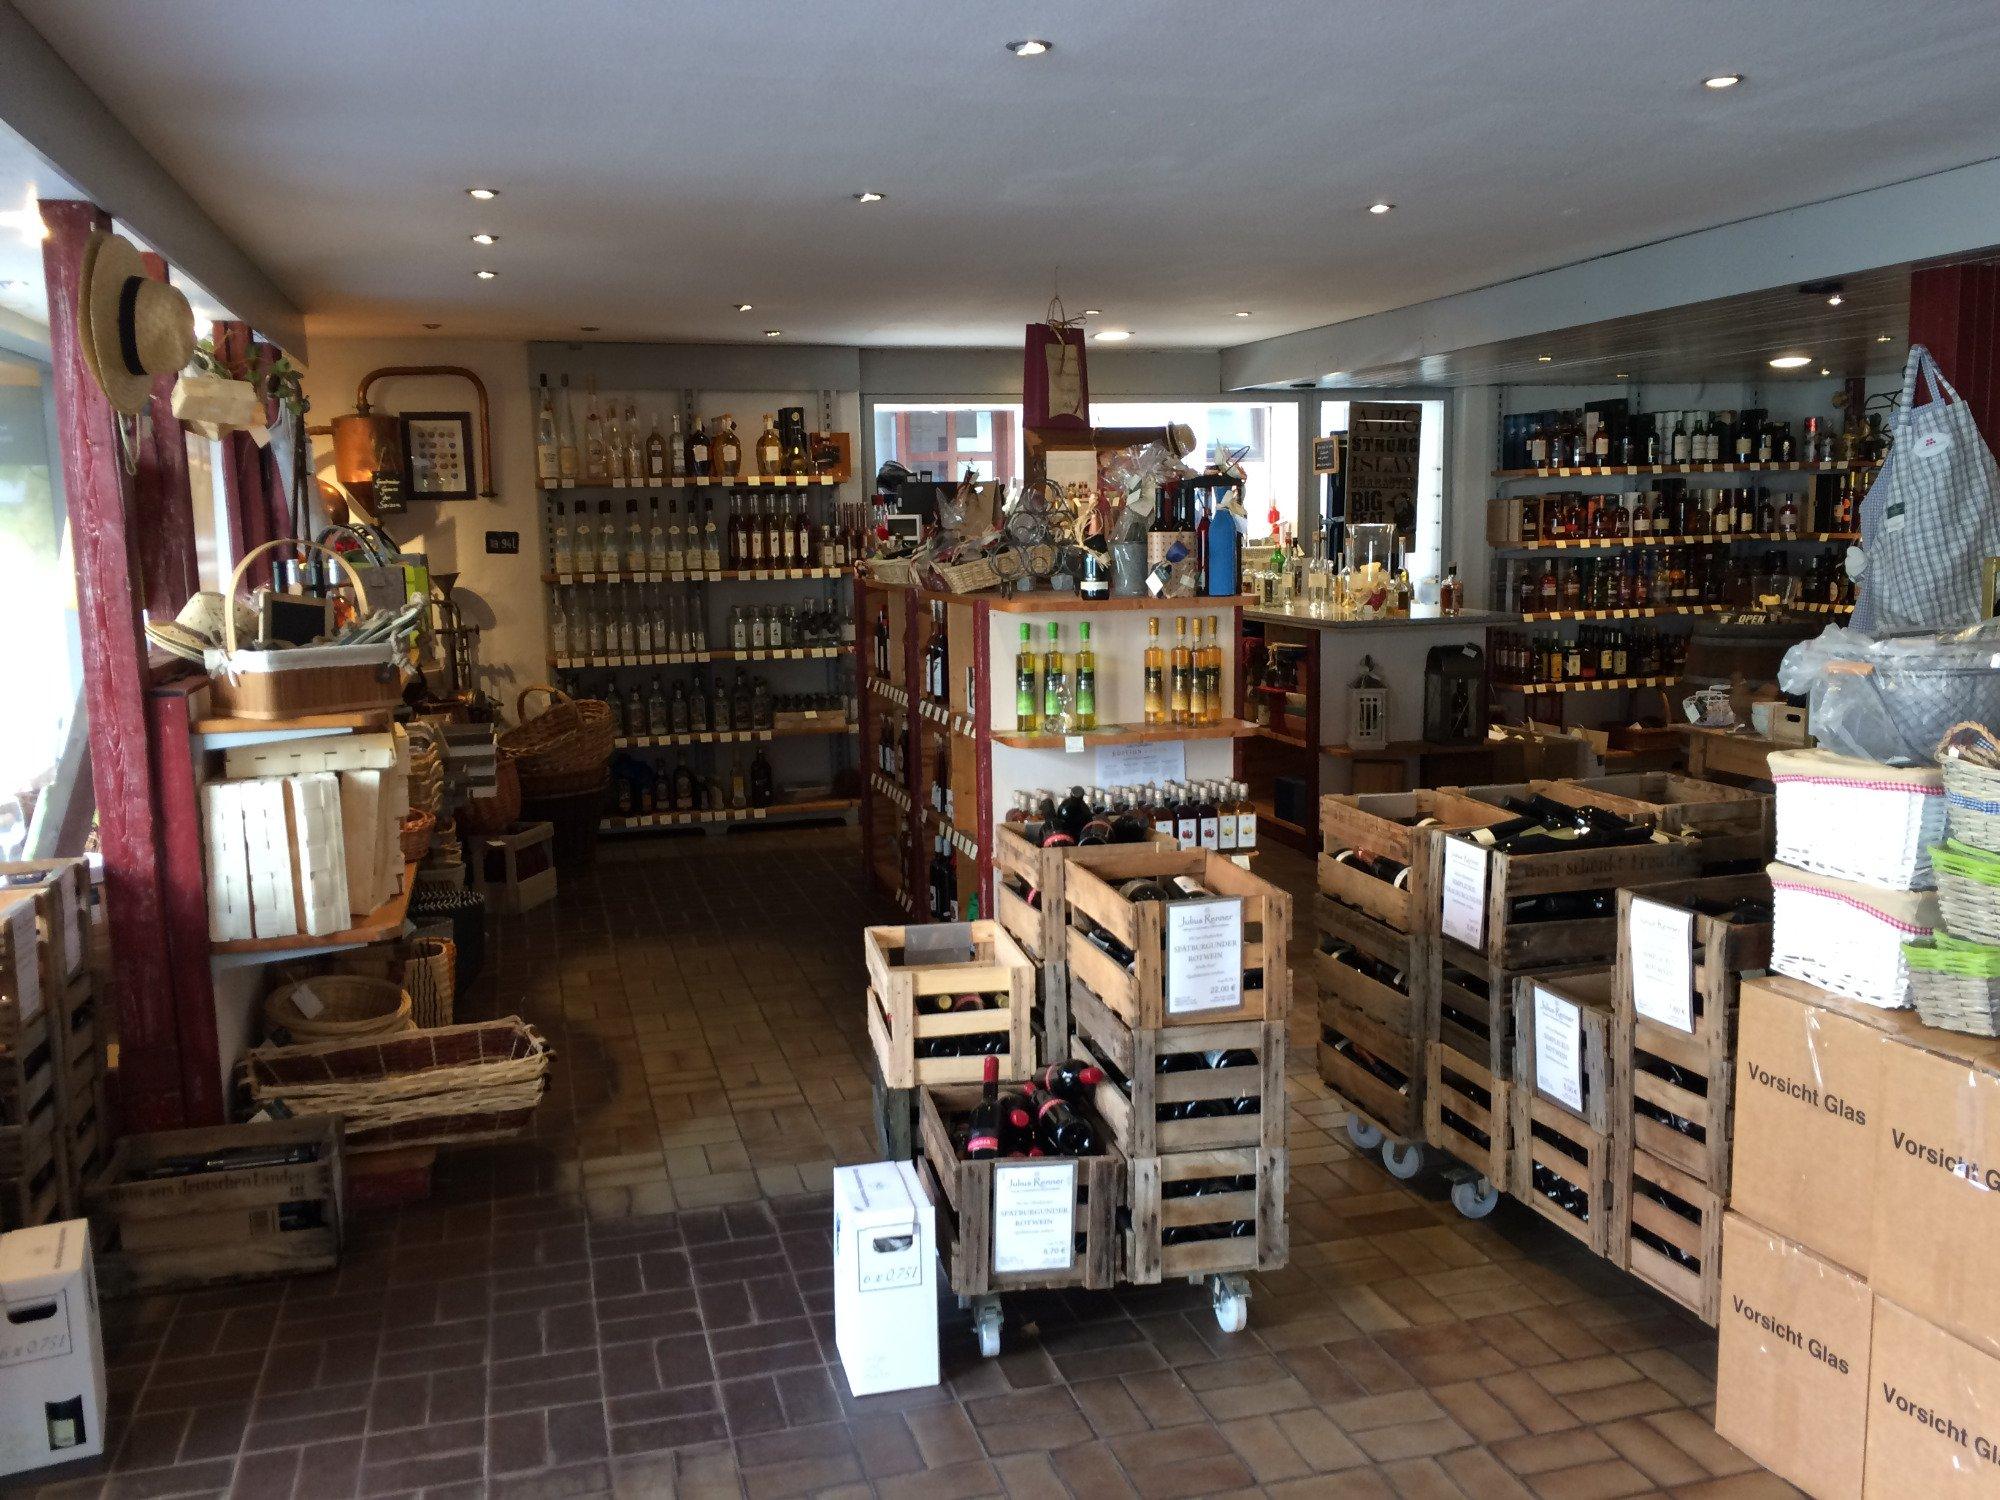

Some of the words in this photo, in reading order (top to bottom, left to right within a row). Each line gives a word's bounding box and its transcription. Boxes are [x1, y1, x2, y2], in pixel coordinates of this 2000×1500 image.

[1354, 407, 1371, 432] A
[1379, 408, 1419, 433] BIG
[1351, 436, 1417, 453] STRONG
[1351, 456, 1414, 473] ISLAY
[1351, 490, 1383, 512] BIG
[1739, 614, 1767, 625] OPEN
[1748, 1061, 1819, 1107] Vorsicht
[1824, 1094, 1867, 1126] Glas
[1733, 1295, 1802, 1350] Vorsicht
[1808, 1339, 1849, 1374] Glas
[1883, 1382, 1967, 1448] Vorsicht
